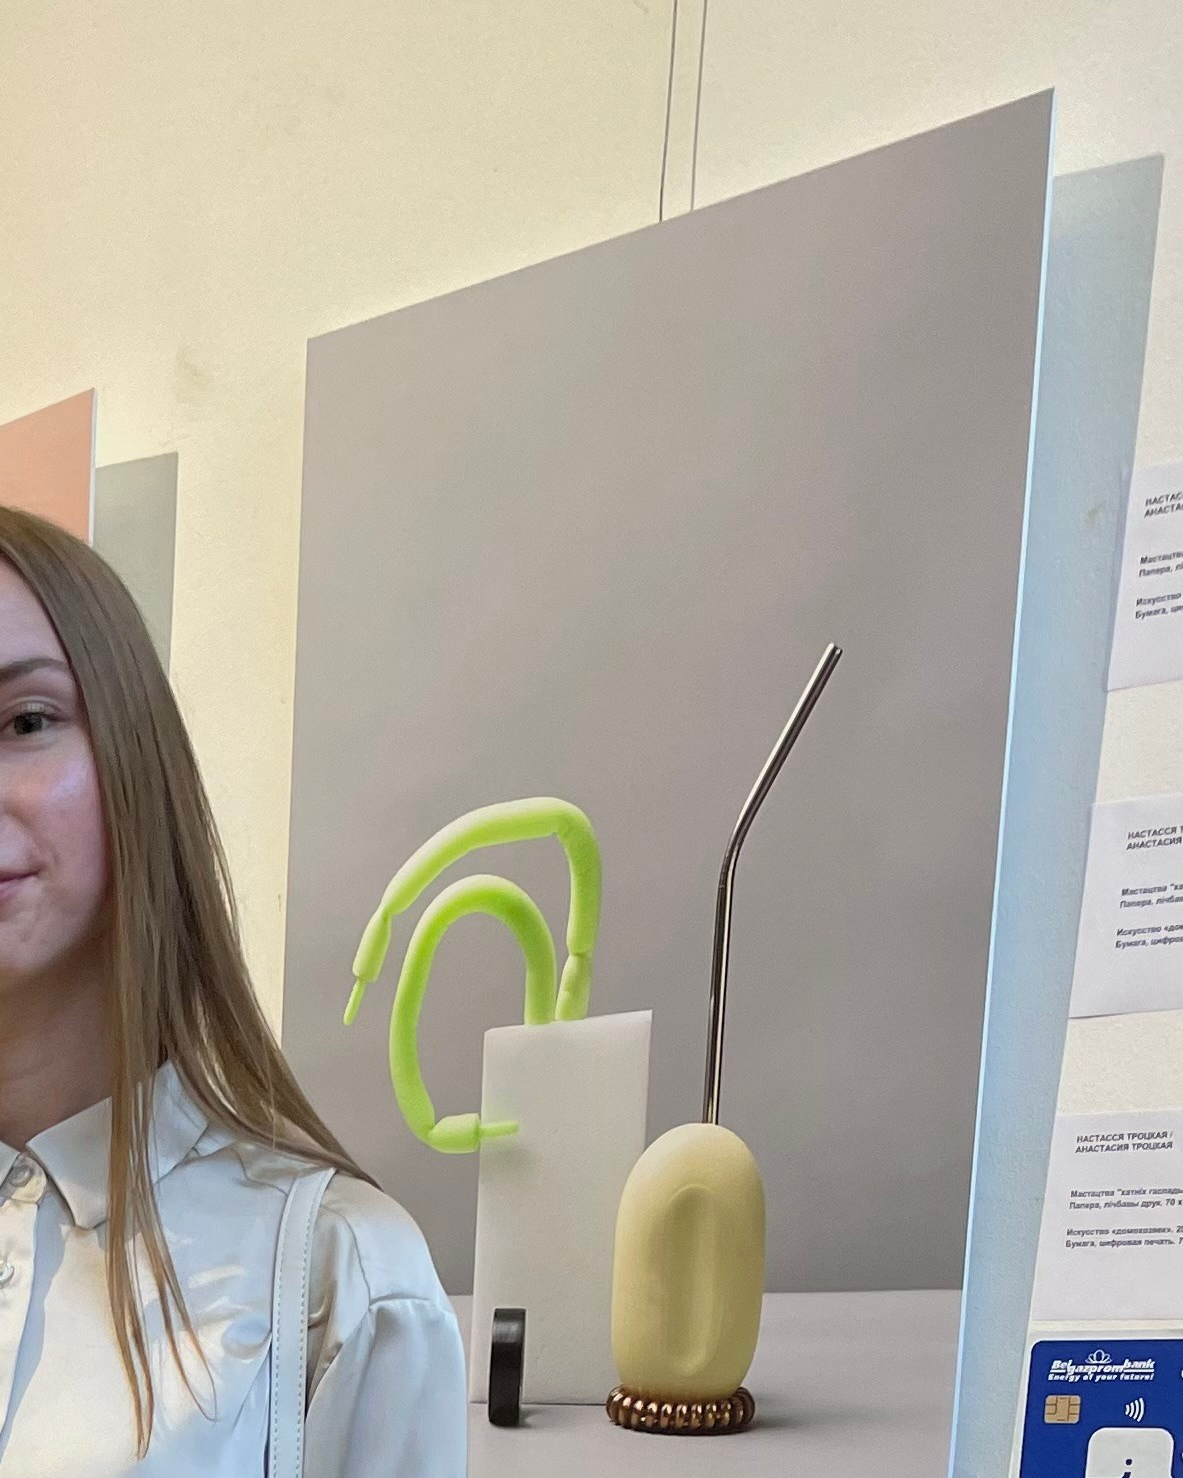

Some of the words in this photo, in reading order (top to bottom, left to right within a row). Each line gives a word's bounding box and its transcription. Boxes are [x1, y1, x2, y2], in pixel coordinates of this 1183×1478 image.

[1127, 826, 1177, 840] НАСТАССЯ
[1126, 836, 1182, 850] АНАСТАСИЯ
[1077, 1133, 1125, 1143] НАСТАССЯ
[1127, 1131, 1168, 1141] ТРОЦКАЯ
[1075, 1143, 1129, 1153] АНАСТАСИЯ
[1132, 1141, 1173, 1151] ТРОЦКАЯ
[1069, 1201, 1101, 1210] Папера,
[1066, 1228, 1109, 1237] Искусство
[1065, 1239, 1096, 1248] Бумага,
[1050, 1358, 1155, 1375] Belgazprombank
[1048, 1373, 1080, 1382] Energy
[1095, 1374, 1117, 1382] your
